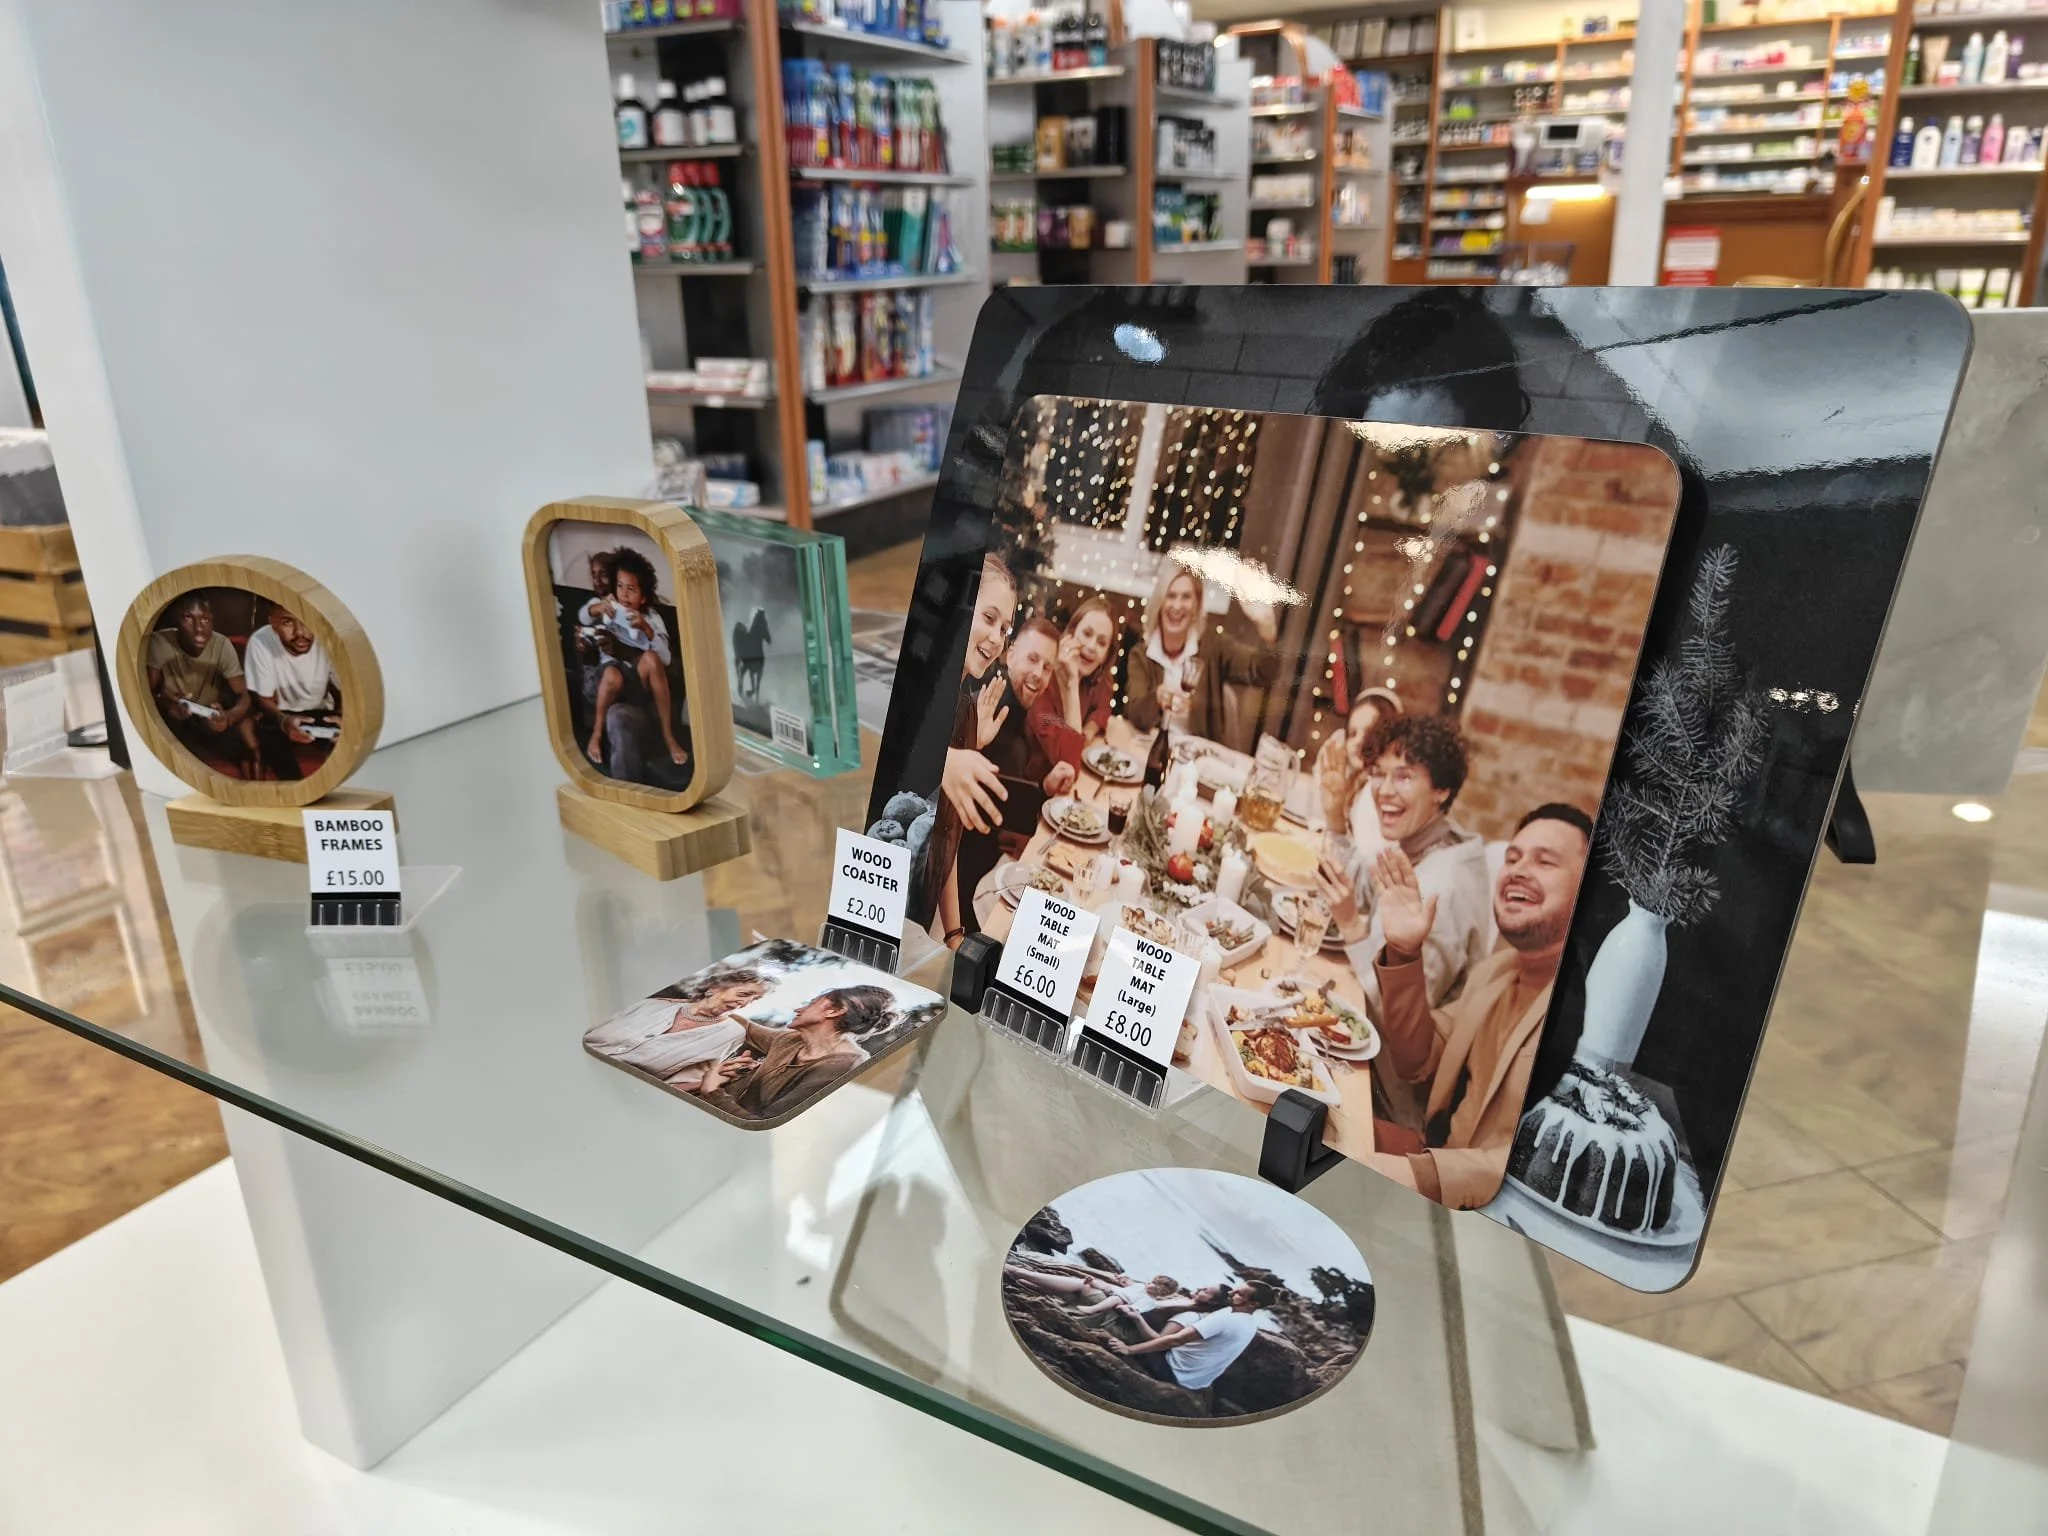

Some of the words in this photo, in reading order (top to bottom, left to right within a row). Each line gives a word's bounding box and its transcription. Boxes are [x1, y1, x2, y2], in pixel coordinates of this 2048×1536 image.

[315, 820, 384, 832] BAMBOO
[321, 839, 383, 851] FRAMES
[851, 847, 892, 869] WOOD
[327, 870, 384, 886] £15.00
[842, 864, 899, 892] COASTER
[847, 897, 886, 923] £2.00
[1044, 899, 1076, 921] WOOD
[1040, 915, 1070, 937] TABLE
[1037, 932, 1060, 950] MAT
[1136, 939, 1173, 964] WOOD
[1026, 945, 1060, 970] (Small)
[1132, 957, 1166, 981] TABLE
[1014, 965, 1056, 998] £6.00
[1130, 975, 1156, 995] MAT
[1117, 989, 1157, 1017] (Large)
[1105, 1010, 1152, 1047] £8.00
